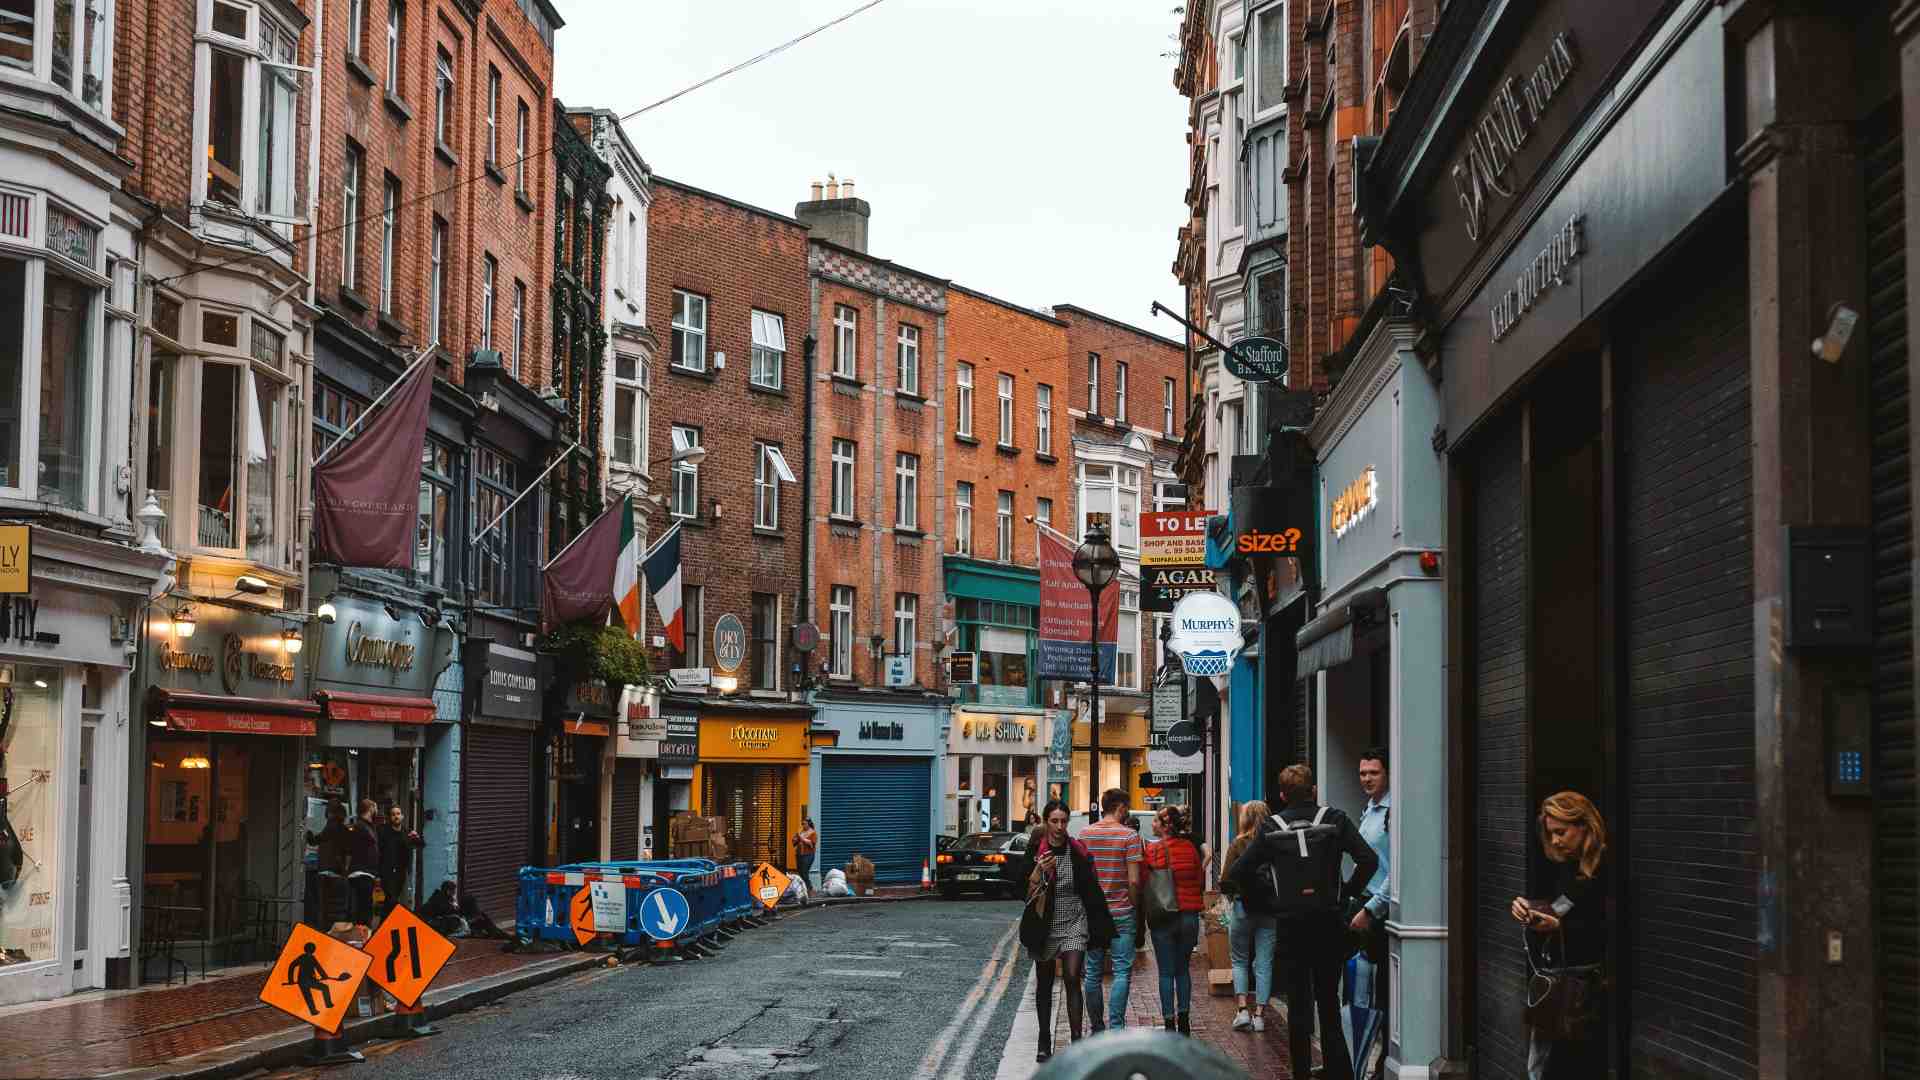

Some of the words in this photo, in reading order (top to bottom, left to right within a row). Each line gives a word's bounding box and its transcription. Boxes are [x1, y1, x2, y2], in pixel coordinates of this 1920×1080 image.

[1524, 32, 1573, 122] DUBLIN
[1517, 213, 1577, 313] BOUTIQUE
[1245, 345, 1282, 362] Stafford
[1156, 518, 1180, 531] TO
[1184, 517, 1207, 531] LE
[1238, 527, 1302, 553] size?
[0, 545, 20, 567] LY
[1182, 617, 1234, 630] MURPHY'S
[490, 670, 507, 687] LOUIS
